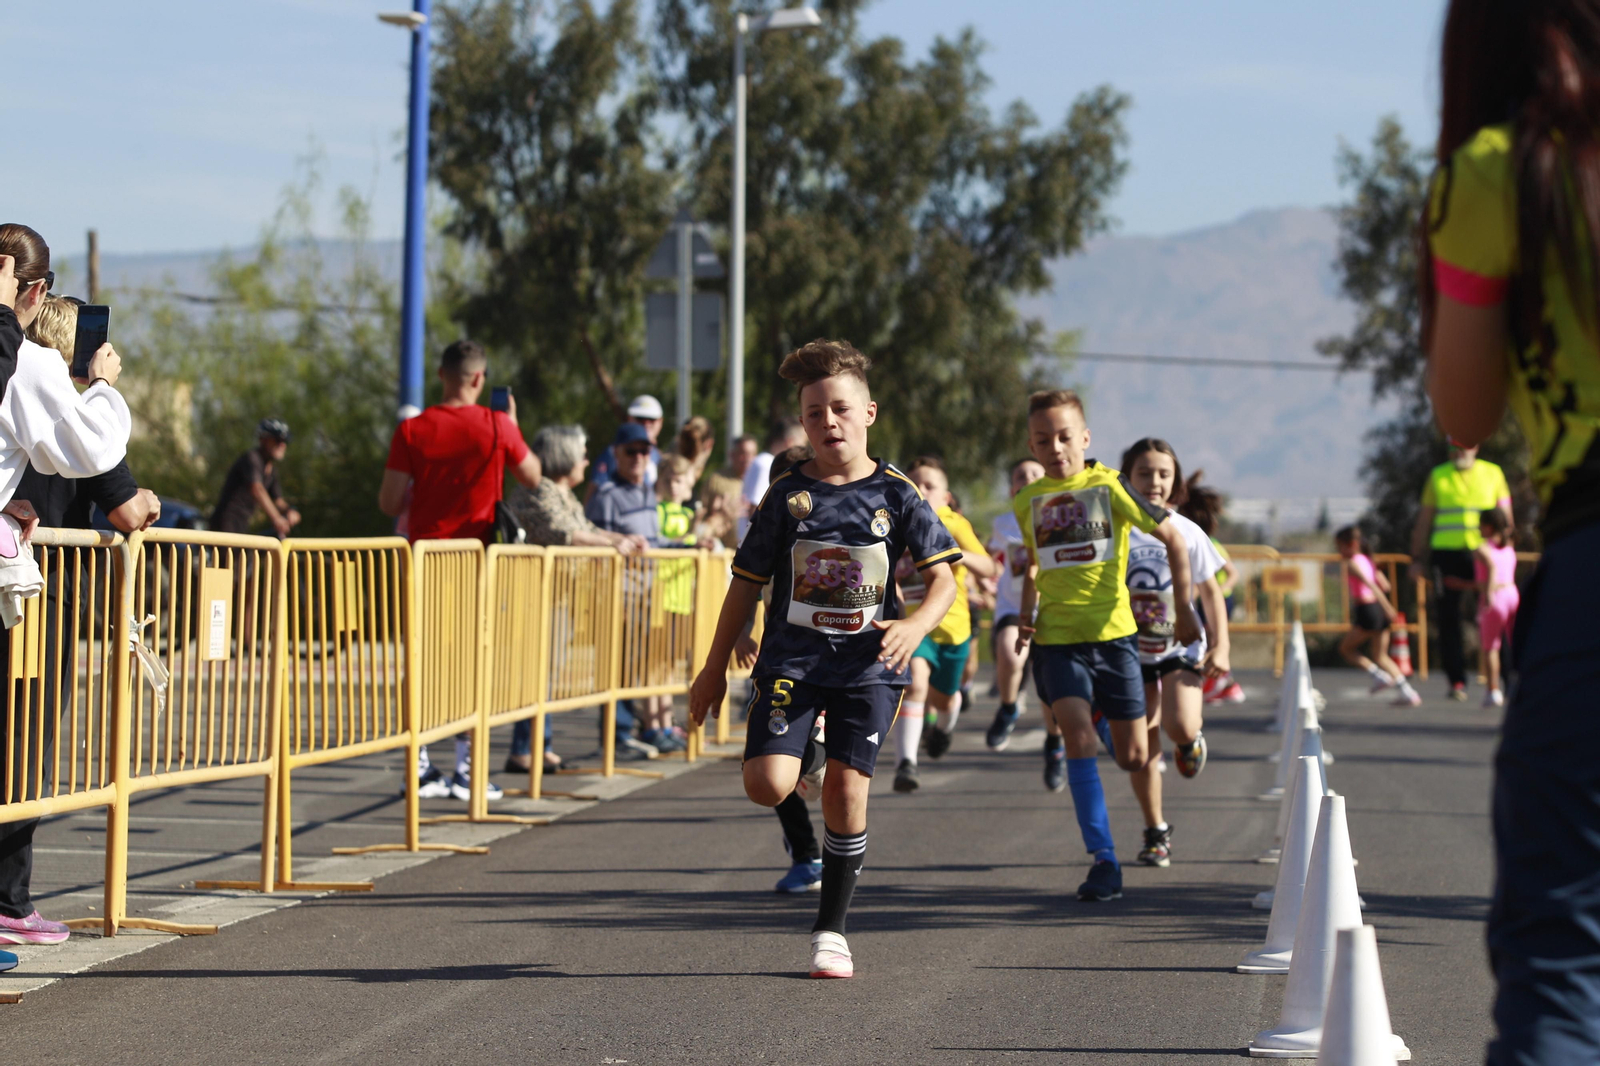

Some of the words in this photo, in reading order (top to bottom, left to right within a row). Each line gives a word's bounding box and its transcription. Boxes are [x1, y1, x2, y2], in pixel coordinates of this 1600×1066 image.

[1042, 501, 1087, 529] 800
[805, 556, 864, 588] 836
[844, 584, 877, 594] XIII
[771, 679, 794, 707] 5
